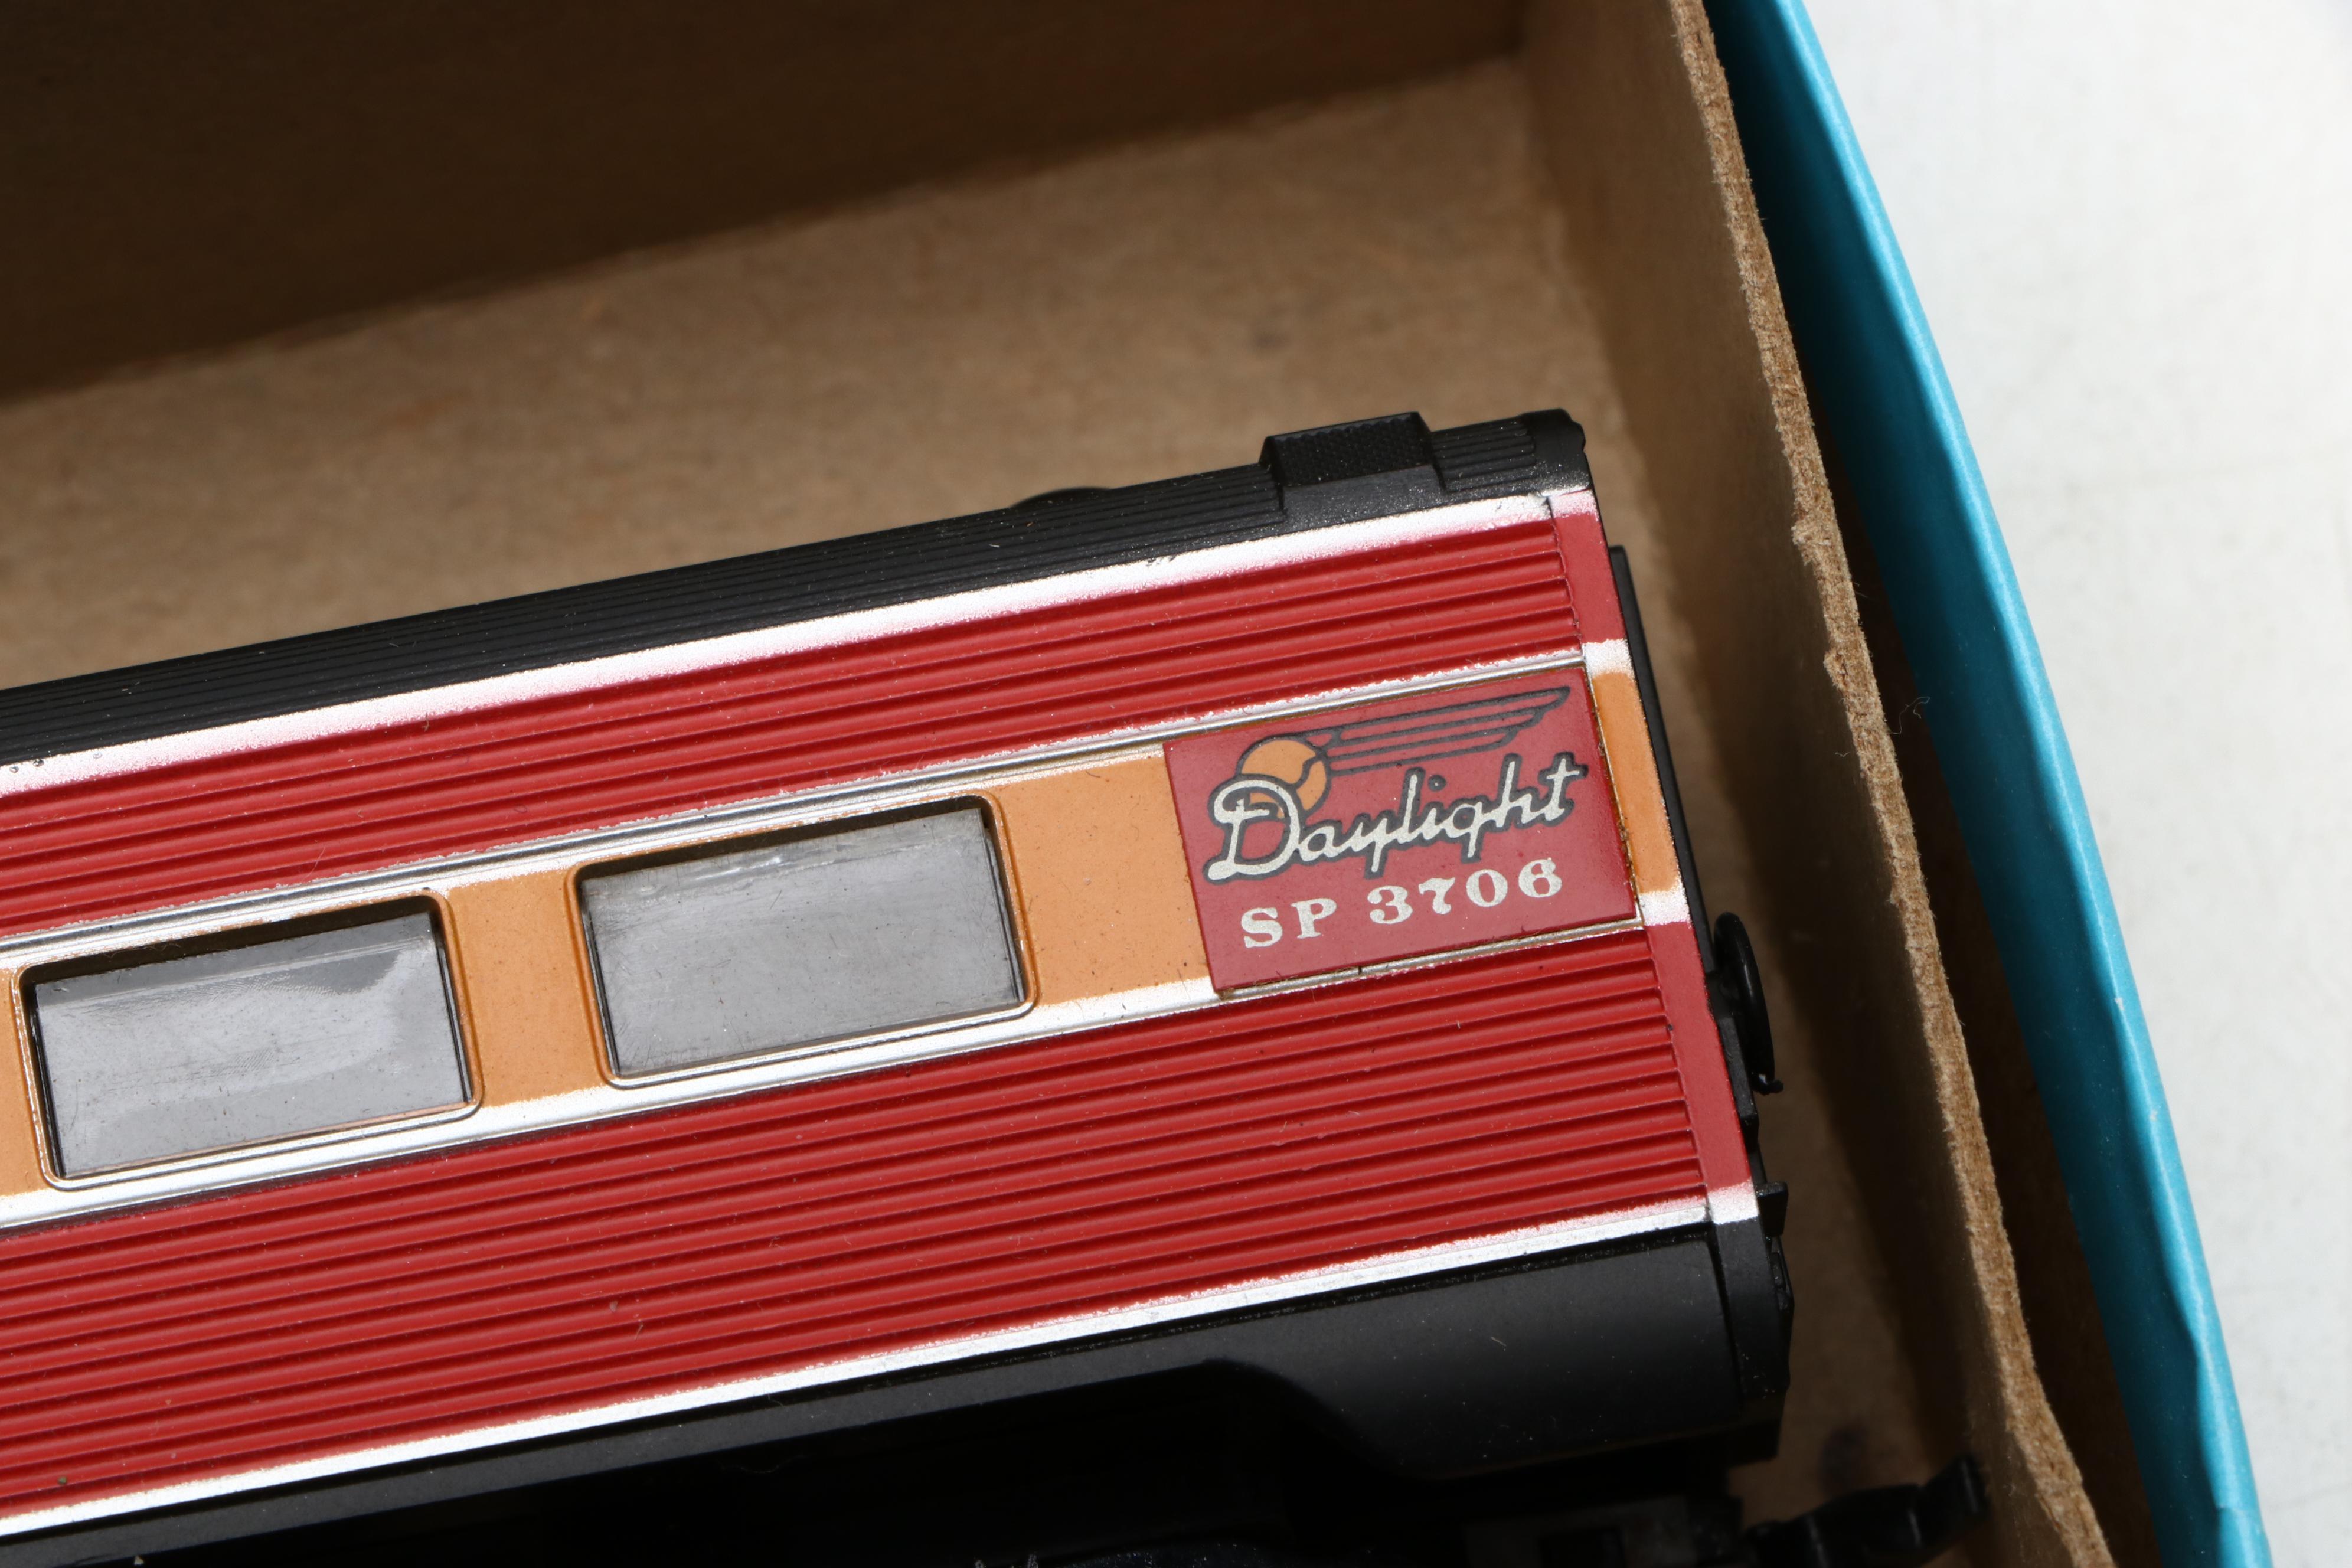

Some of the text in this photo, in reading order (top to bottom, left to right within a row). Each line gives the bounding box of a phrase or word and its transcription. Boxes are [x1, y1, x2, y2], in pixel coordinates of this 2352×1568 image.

[1206, 754, 1585, 883] Daylight
[1240, 857, 1563, 948] SP 3706
